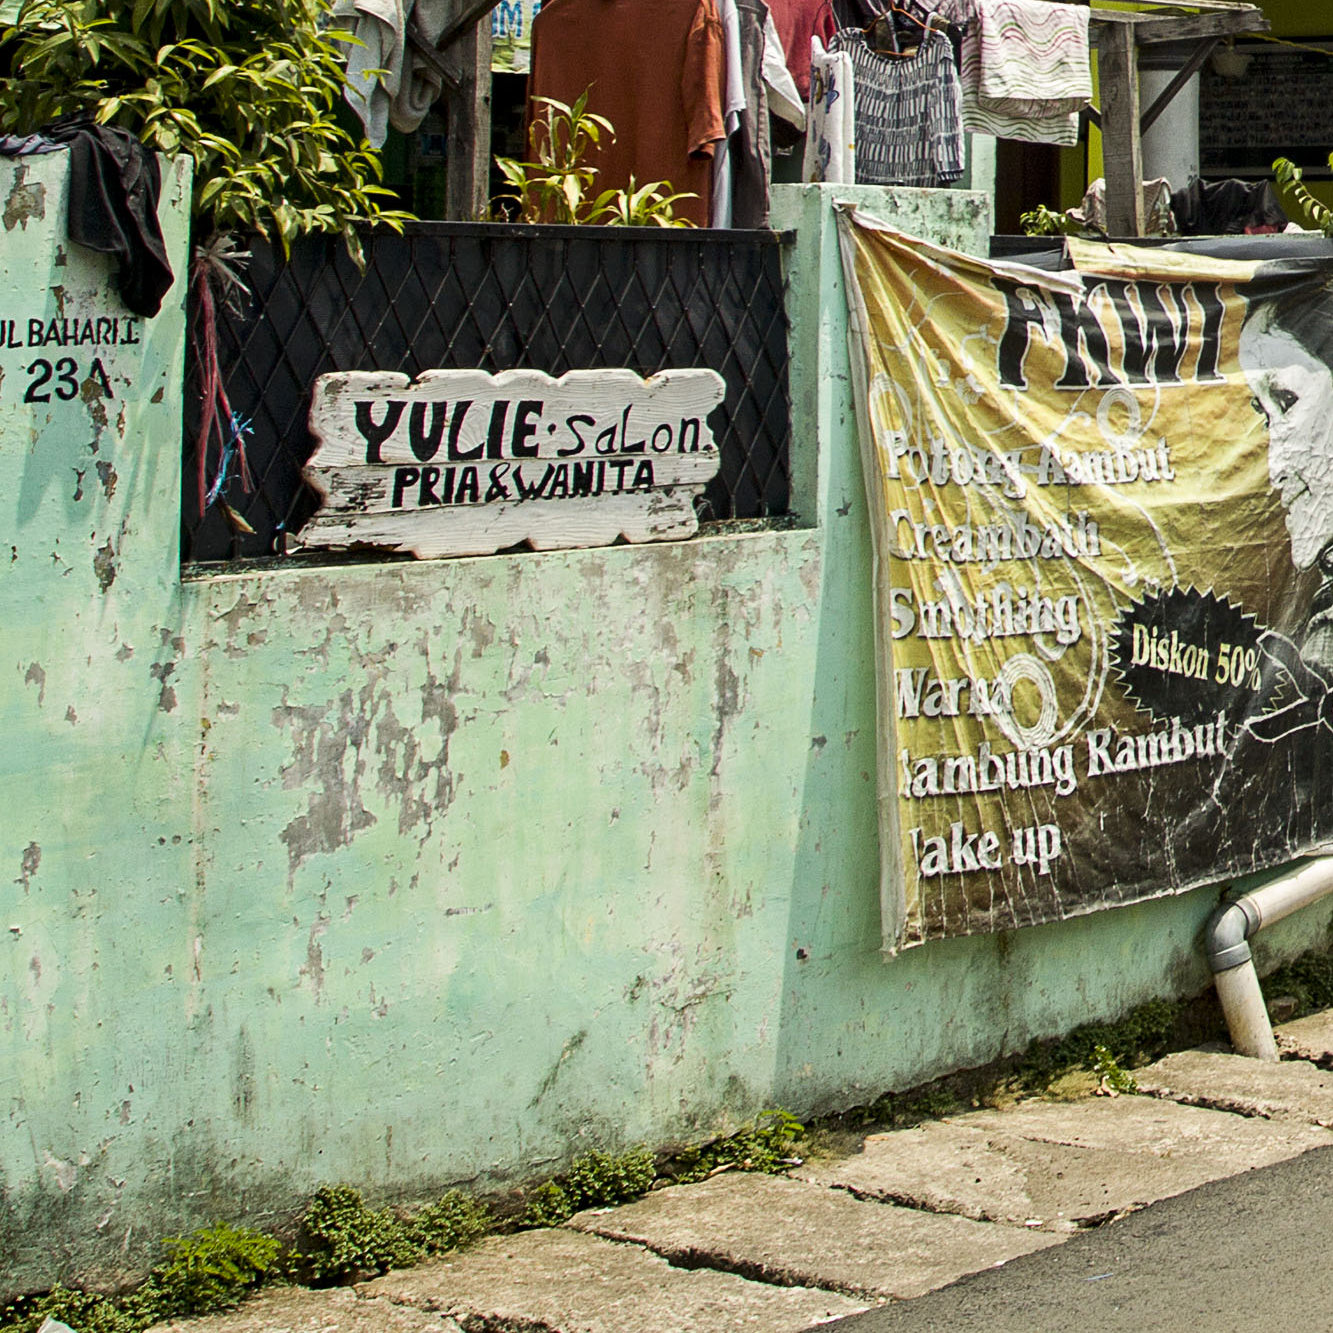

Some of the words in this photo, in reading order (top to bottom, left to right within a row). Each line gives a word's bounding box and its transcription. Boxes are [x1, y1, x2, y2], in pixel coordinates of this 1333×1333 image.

[27, 317, 119, 347] BAHARI
[354, 400, 544, 463] YULIE
[1131, 623, 1209, 680] Diskon
[1215, 642, 1262, 692] 50%
[898, 741, 1078, 798] ambung
[1087, 709, 1229, 777] Rambut
[909, 821, 1002, 877] ake
[1009, 823, 1062, 876] up
